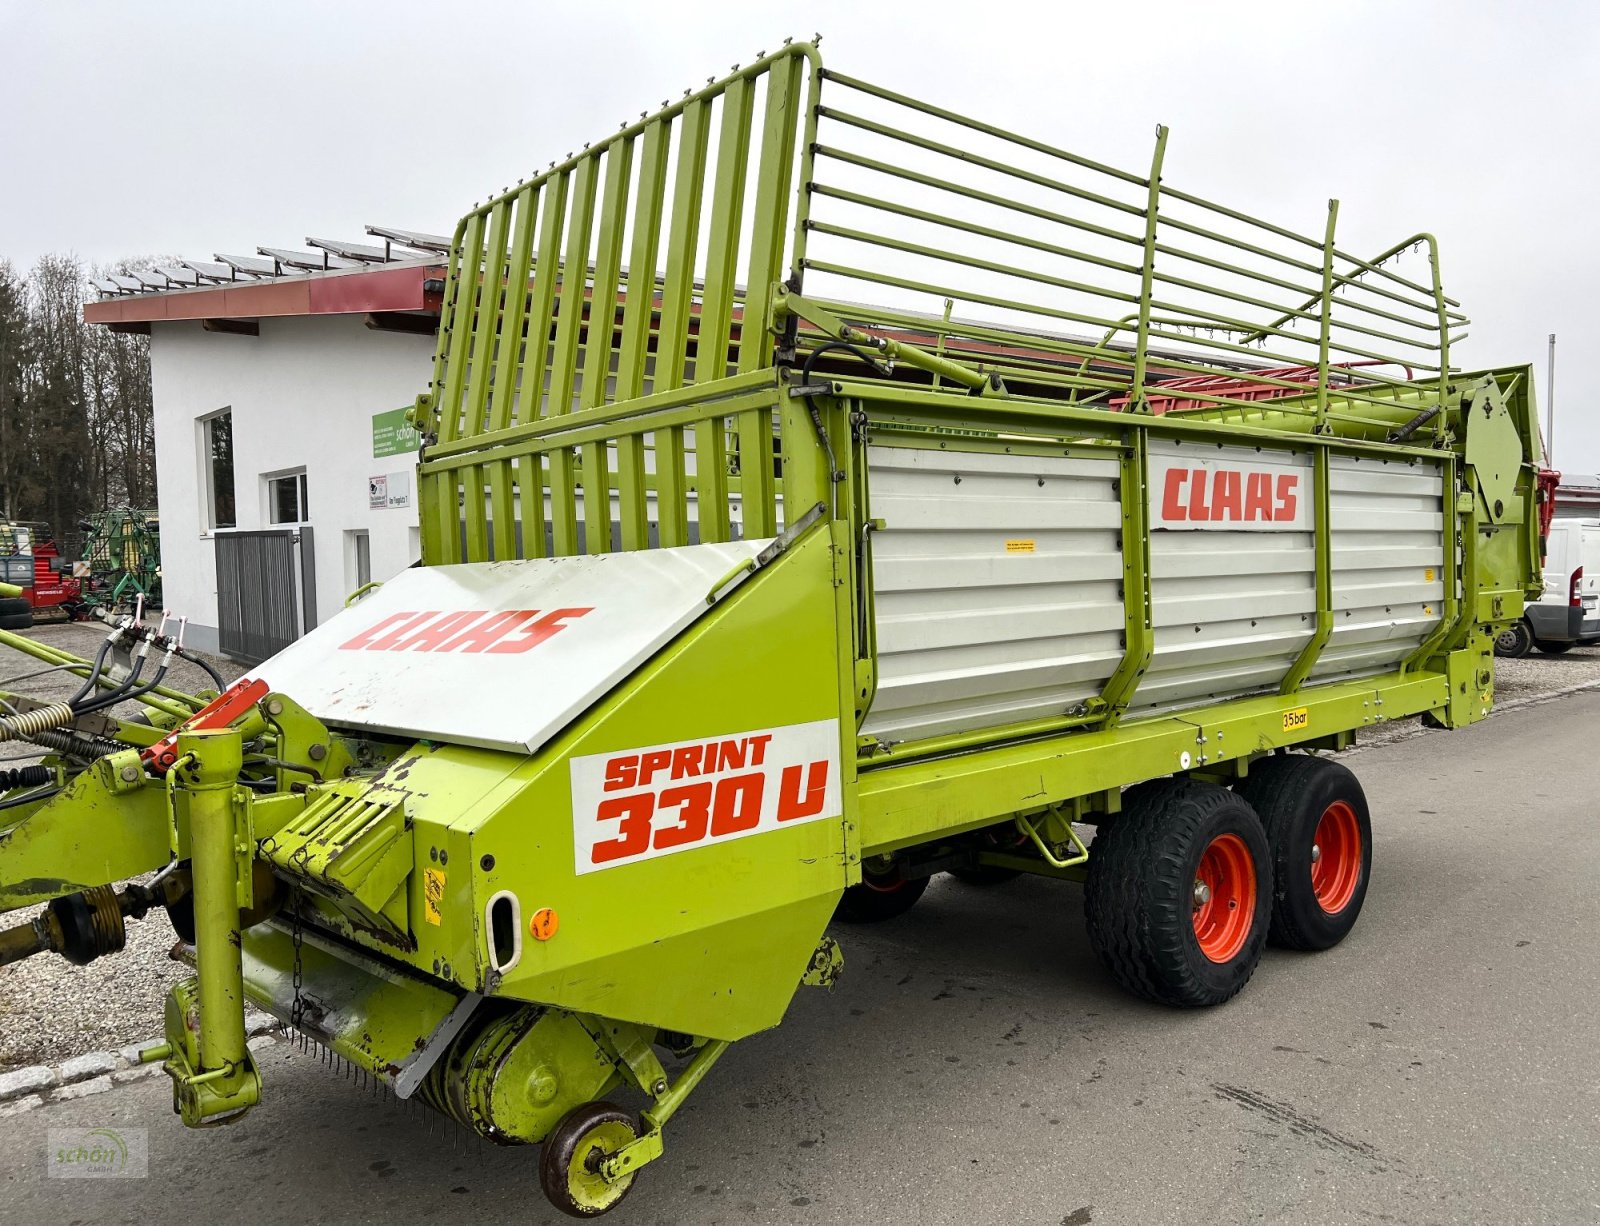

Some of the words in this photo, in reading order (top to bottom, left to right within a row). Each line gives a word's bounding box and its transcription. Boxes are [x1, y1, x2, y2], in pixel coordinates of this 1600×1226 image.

[1162, 468, 1298, 521] CLAAS
[338, 607, 596, 654] CLAAS
[603, 733, 773, 793] SPRINT
[591, 771, 766, 865] 330
[776, 759, 829, 823] U
